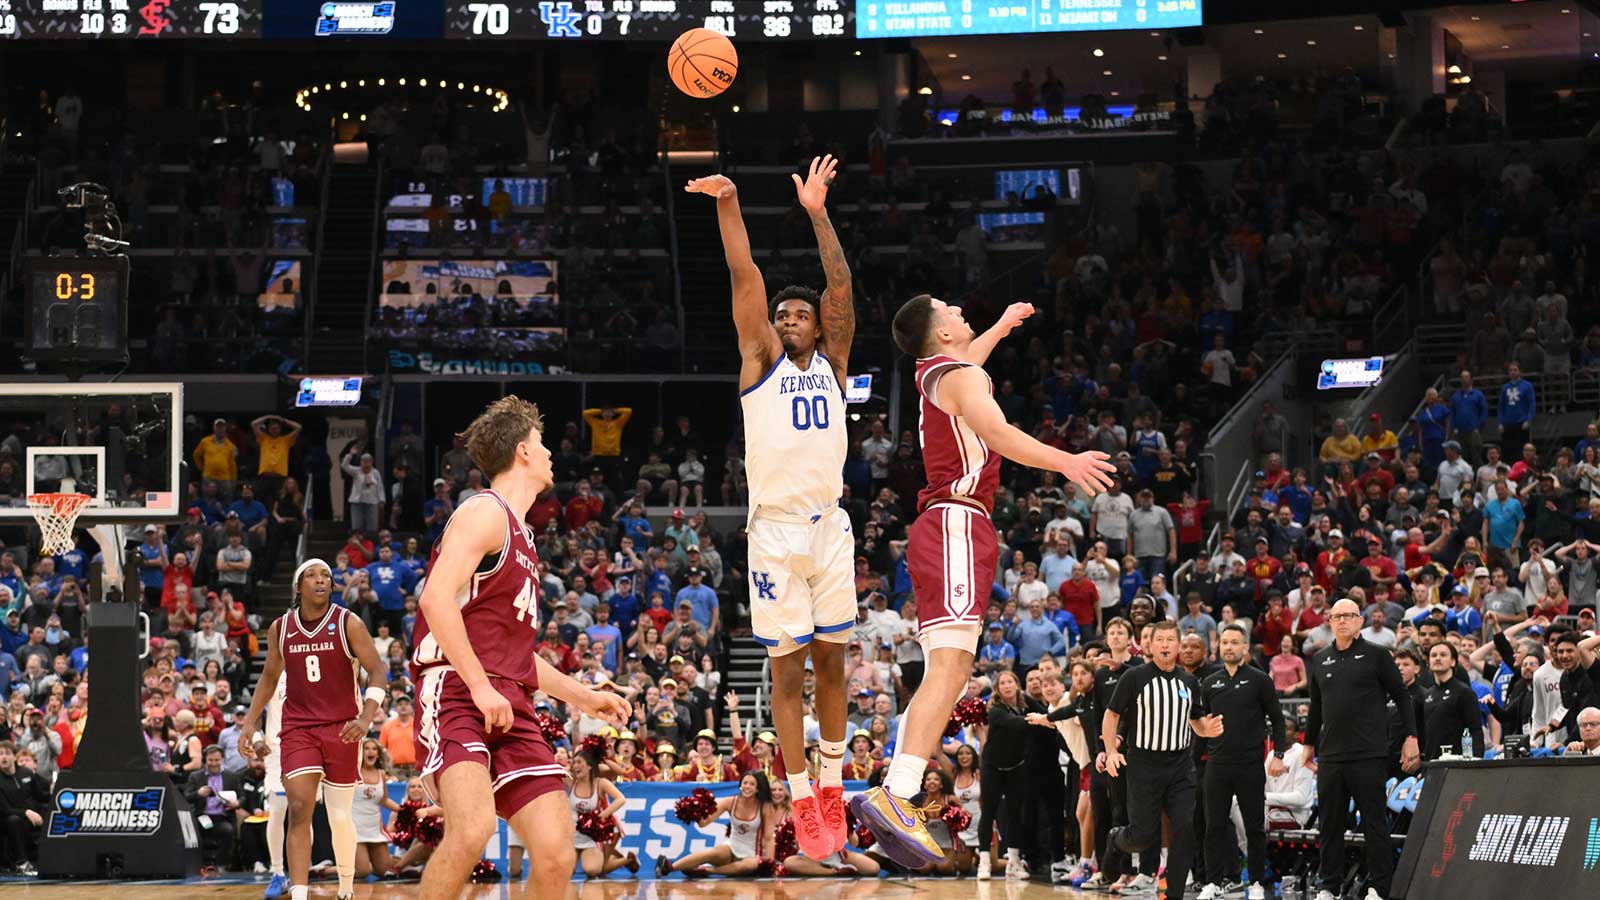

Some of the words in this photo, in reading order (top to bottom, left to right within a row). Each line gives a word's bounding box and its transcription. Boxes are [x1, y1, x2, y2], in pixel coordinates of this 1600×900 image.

[585, 1, 605, 12] TOL
[613, 1, 633, 12] FLS
[885, 2, 947, 15] VILLANOVA
[1136, 8, 1148, 23] 0
[80, 13, 104, 34] 10
[111, 13, 126, 34] 3
[199, 3, 240, 34] 73
[468, 3, 509, 35] 70
[587, 15, 602, 35] 0
[617, 15, 631, 35] 7
[885, 17, 915, 30] UTAH
[916, 16, 952, 30] STATE
[961, 13, 973, 28] 0
[56, 273, 95, 300] 0.3
[792, 395, 830, 431] 00
[512, 576, 538, 630] 44
[289, 644, 311, 654] SANTA
[311, 642, 335, 652] CLARA
[305, 655, 321, 682] 8
[75, 792, 134, 810] MARCH
[81, 810, 160, 829] MADNESS
[1468, 814, 1523, 863] SANTA
[1512, 815, 1570, 867] CLARA
